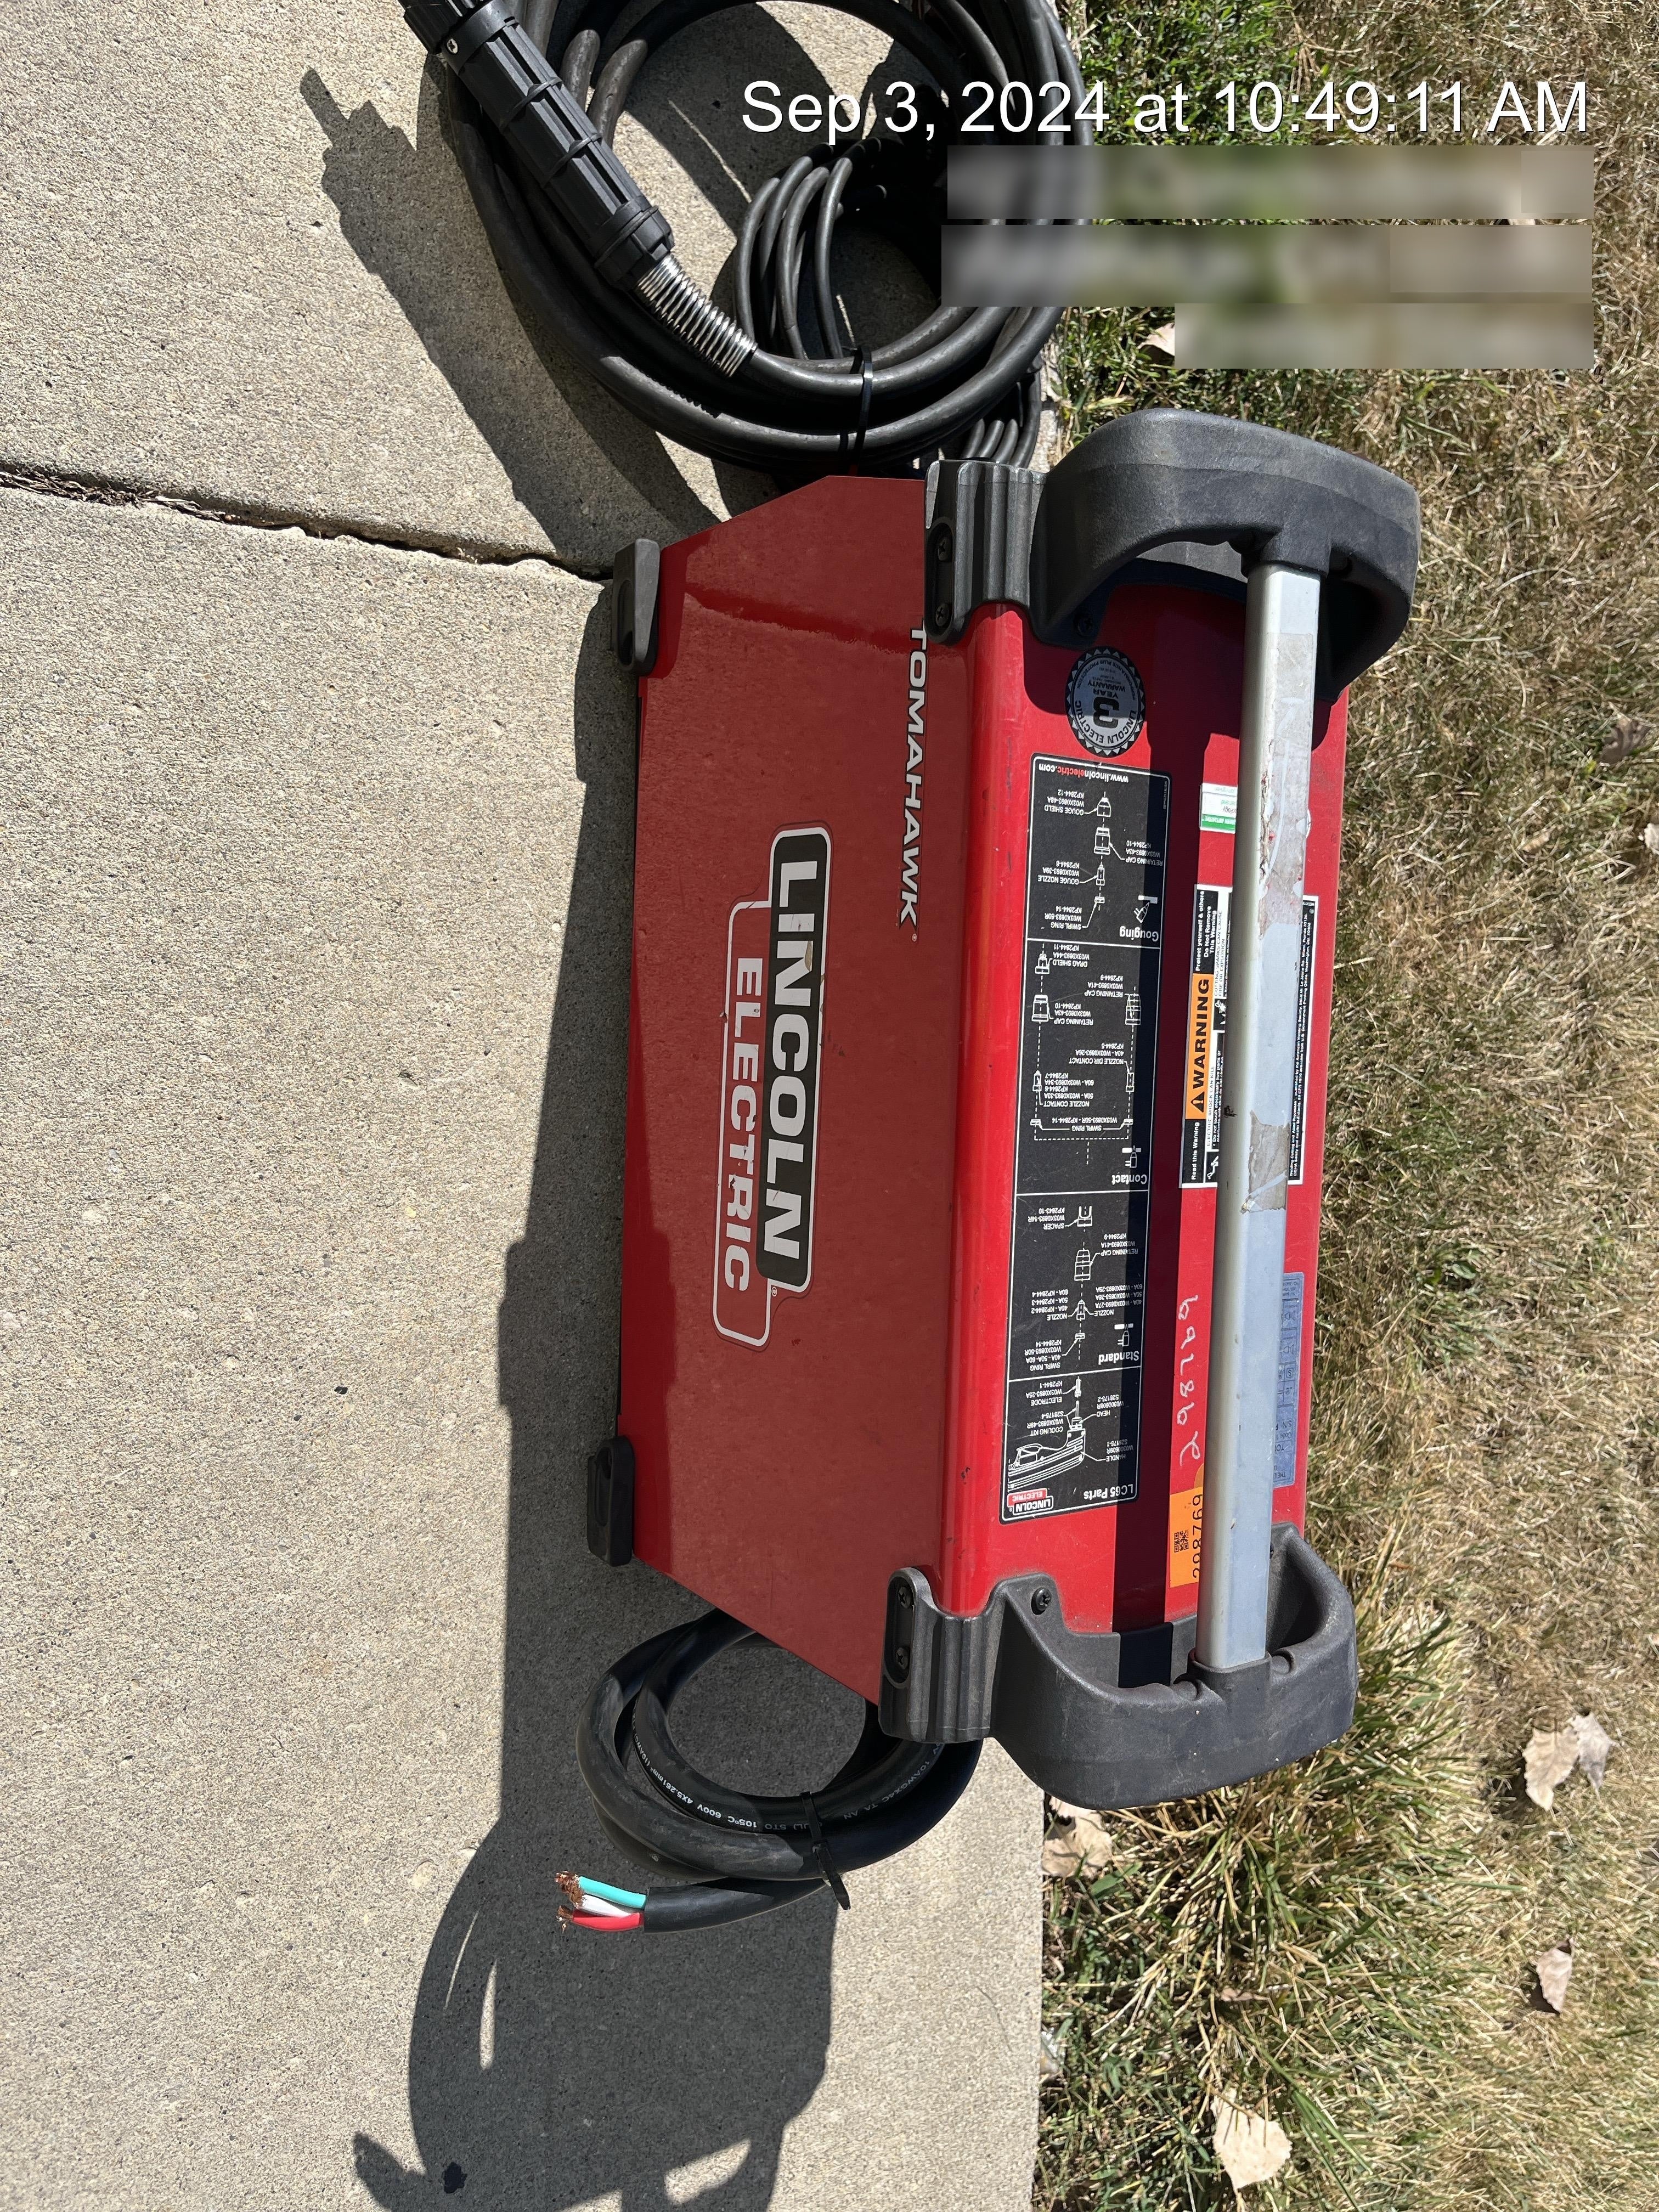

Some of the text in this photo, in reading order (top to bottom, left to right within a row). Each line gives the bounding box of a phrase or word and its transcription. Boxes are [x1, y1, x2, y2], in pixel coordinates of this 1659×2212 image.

[1087, 680, 1125, 692] WARRANTY
[1093, 689, 1118, 698] YEAR
[1093, 697, 1119, 729] 3
[1075, 701, 1137, 744] LINCOLN ELECTRIC
[900, 620, 927, 927] TOMAHAWK
[1039, 764, 1128, 783] www.lincolnelectric.com
[1058, 789, 1084, 798] KP2844-12
[1044, 805, 1084, 816] GOUGE SHIELD
[1137, 857, 1163, 866] RETAINING
[1037, 875, 1079, 885] GOUGE NOZZLE
[1119, 926, 1159, 942] Gouging
[1203, 948, 1209, 957] Do
[1192, 979, 1210, 1089] WARNING
[764, 861, 817, 1259] LINCOLN
[725, 958, 763, 1291] ELECTRIC
[1111, 1175, 1147, 1185] Contact
[1098, 1351, 1139, 1364] Standard
[1031, 1397, 1062, 1406] ELECTRODE
[1040, 1426, 1063, 1435] COOLING
[1012, 1491, 1043, 1502] ELECTRIC
[1084, 1484, 1133, 1500] LC65 Parts
[1015, 1499, 1051, 1512] LINCOLN
[697, 1804, 723, 1819] 600V
